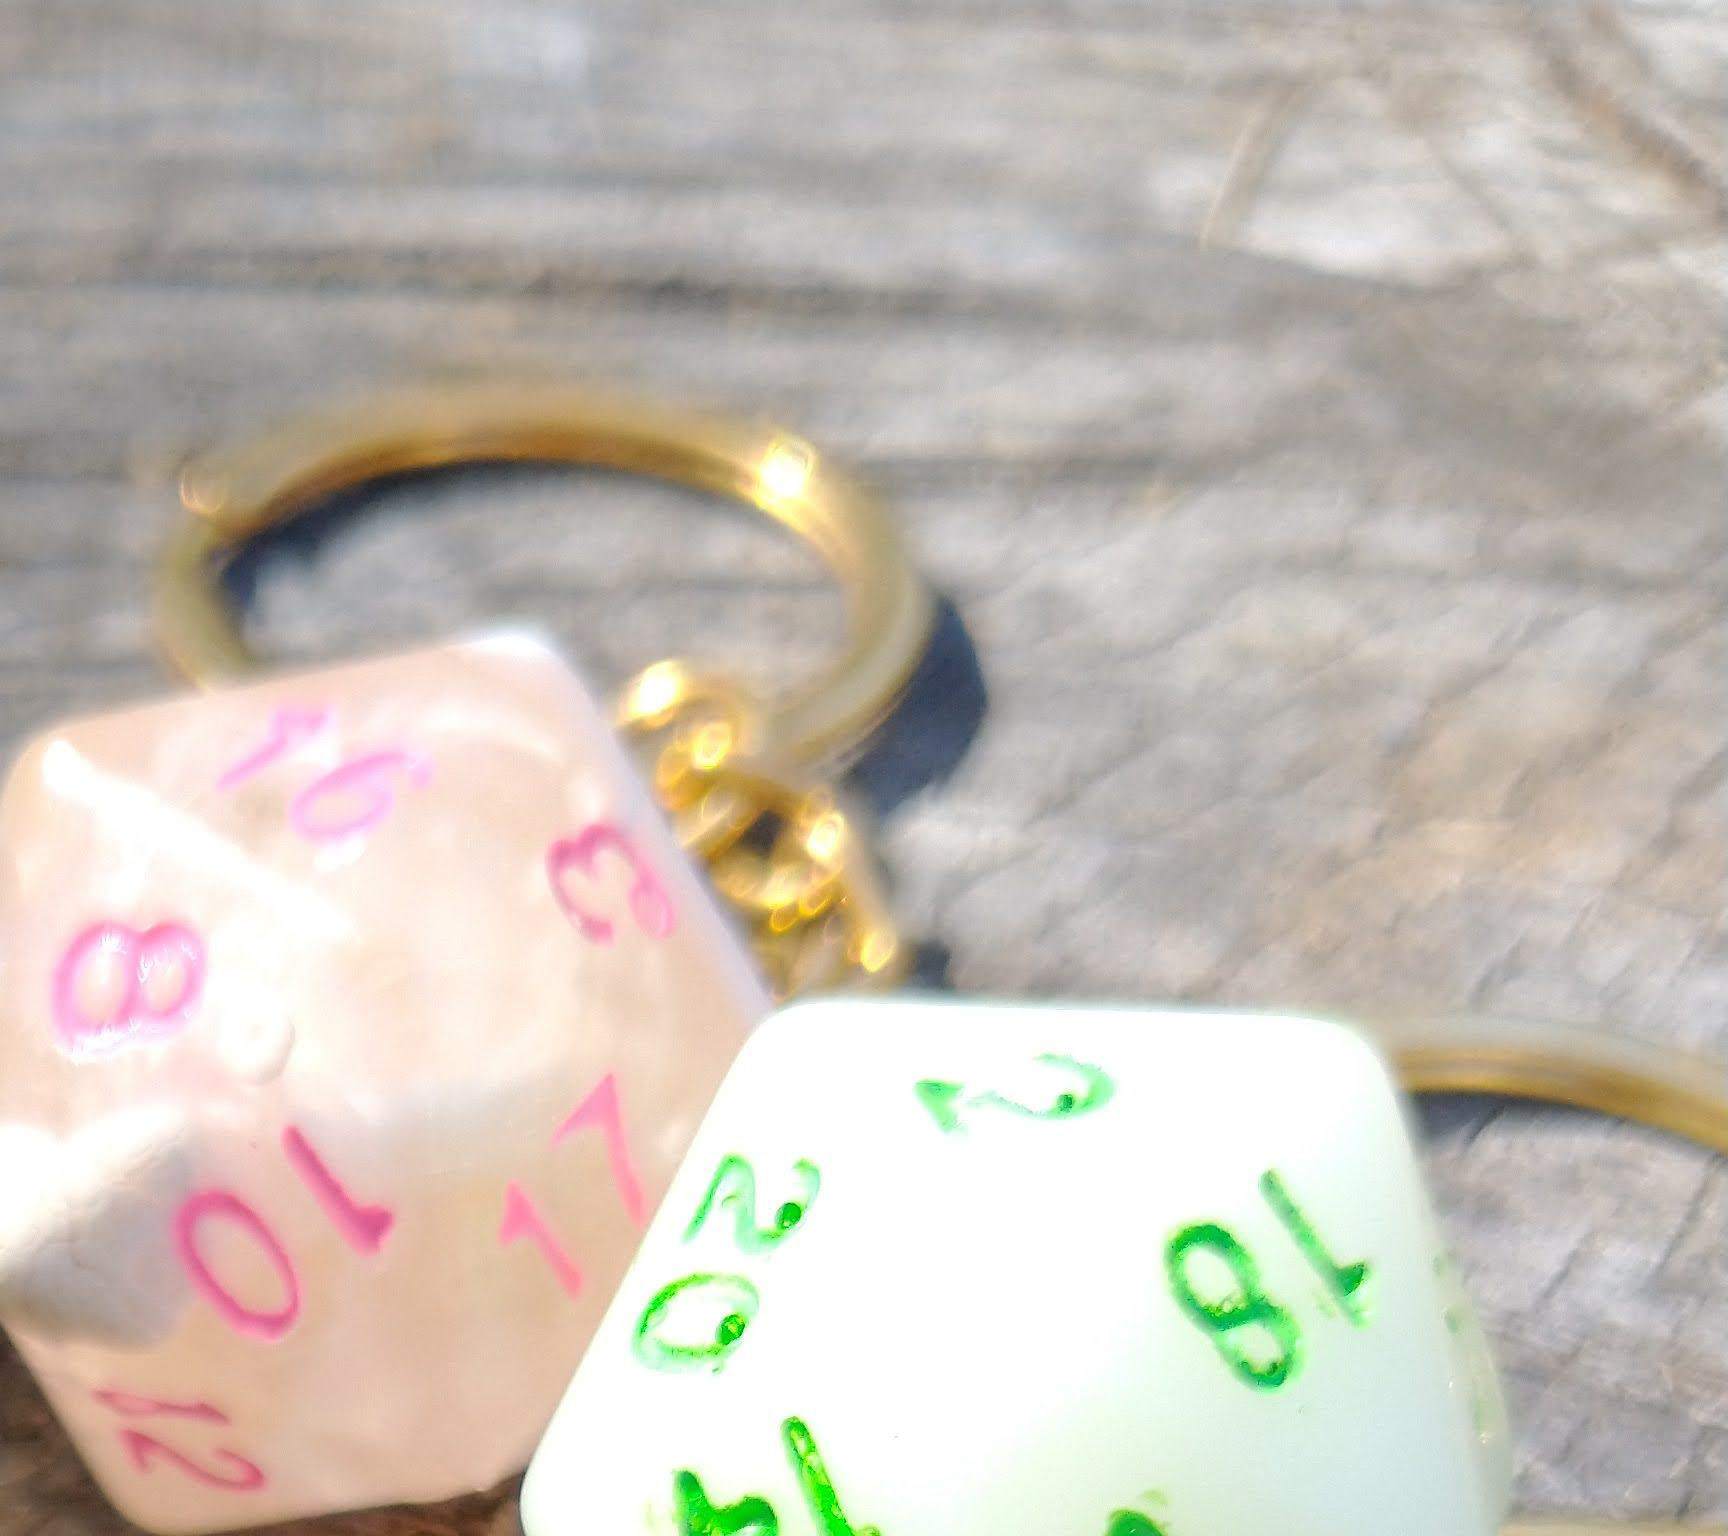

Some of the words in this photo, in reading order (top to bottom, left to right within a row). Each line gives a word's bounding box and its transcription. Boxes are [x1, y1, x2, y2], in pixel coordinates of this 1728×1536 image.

[218, 705, 433, 842] 16
[548, 823, 672, 943] 3
[53, 921, 206, 1059] 8
[915, 1053, 1117, 1132] 2
[175, 1126, 393, 1341] 10
[499, 1072, 646, 1301] 17
[633, 1155, 822, 1374] 20
[1165, 1169, 1374, 1392] 18
[93, 1387, 265, 1493] 12
